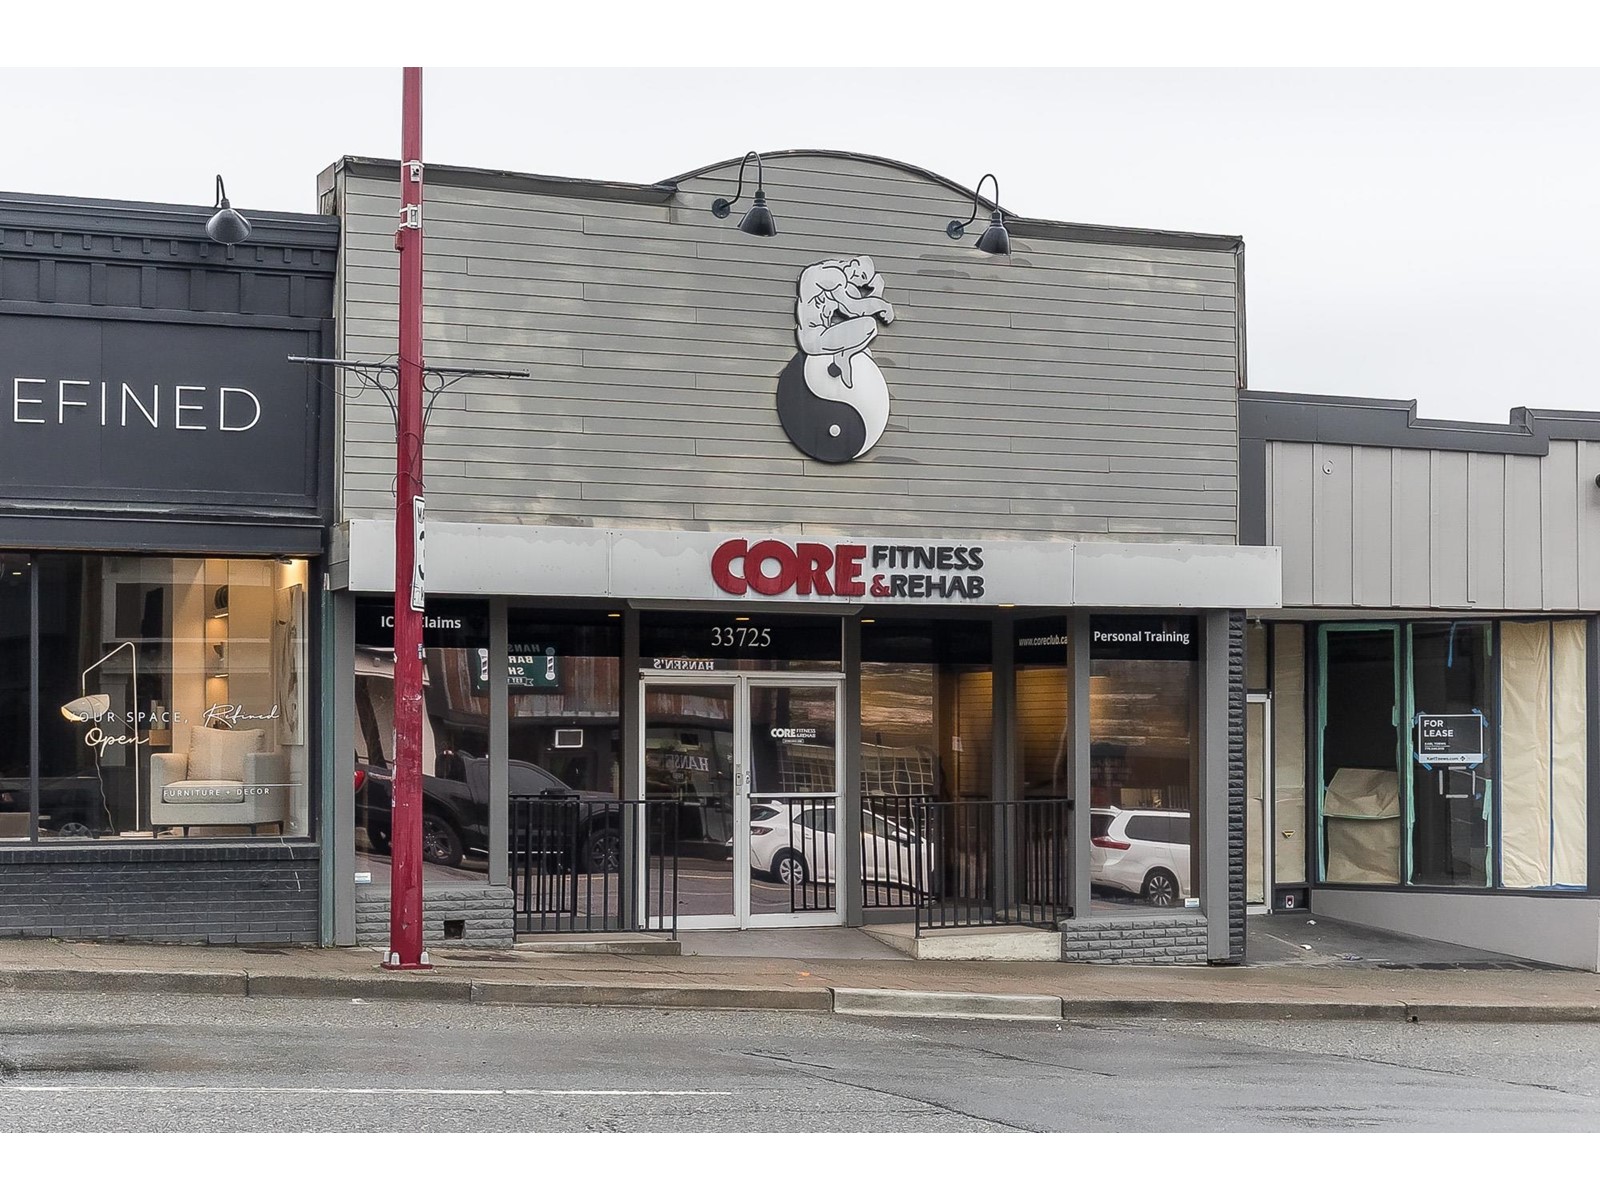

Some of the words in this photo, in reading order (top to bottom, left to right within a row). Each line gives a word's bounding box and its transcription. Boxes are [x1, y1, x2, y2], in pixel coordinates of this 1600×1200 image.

[13, 377, 261, 431] EFINED
[872, 545, 984, 570] FITNESS
[711, 538, 867, 596] CORE
[870, 574, 985, 598] &REHAB
[422, 616, 461, 628] laims
[711, 627, 771, 647] 33725
[1018, 634, 1068, 646] www.coreclub.ca
[1093, 631, 1142, 642] Personal
[1144, 631, 1190, 644] Training
[1423, 719, 1444, 728] FOR
[770, 728, 796, 738] CORE
[1423, 729, 1454, 738] LEASE
[85, 727, 149, 757] Open
[163, 788, 221, 797] FURNITURE
[236, 787, 270, 796] DECOR
